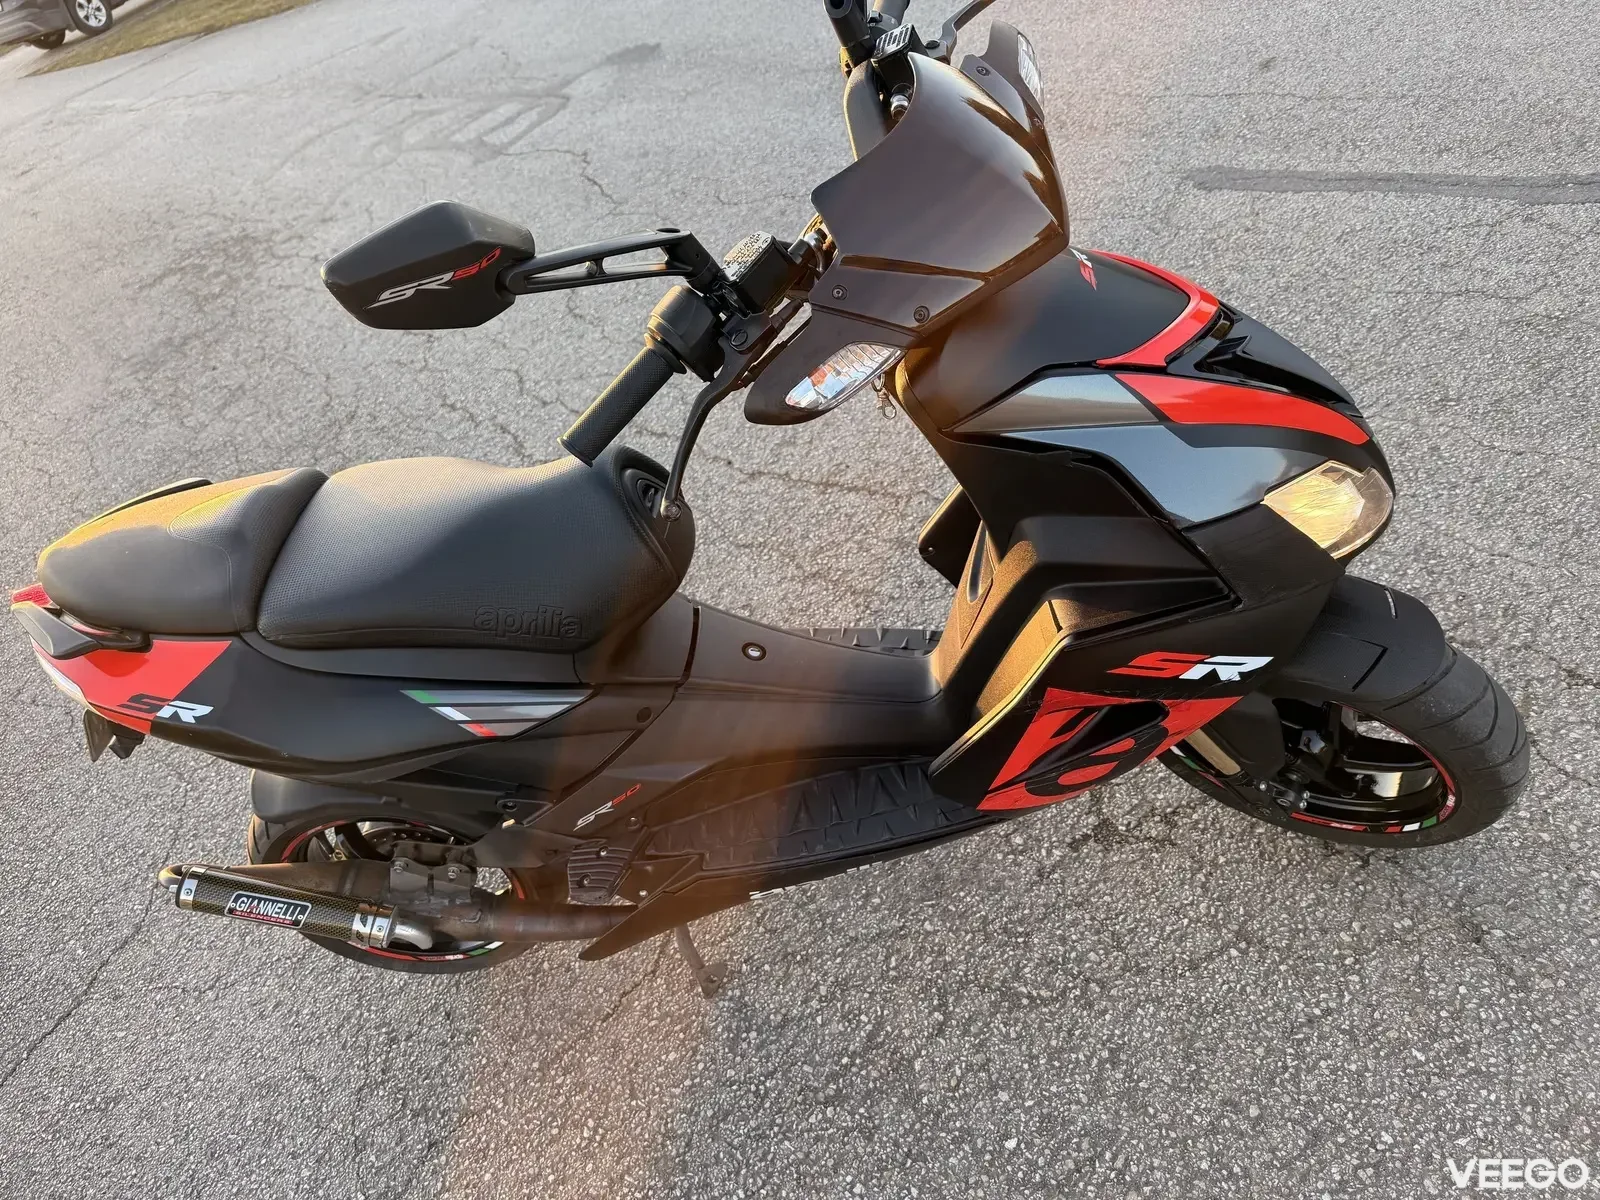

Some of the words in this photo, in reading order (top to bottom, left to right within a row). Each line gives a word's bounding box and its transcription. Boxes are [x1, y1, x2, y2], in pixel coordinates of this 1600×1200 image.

[474, 605, 583, 638] aprilia
[1106, 651, 1274, 681] SR
[117, 693, 215, 723] SR
[236, 897, 301, 920] GIANNELLI
